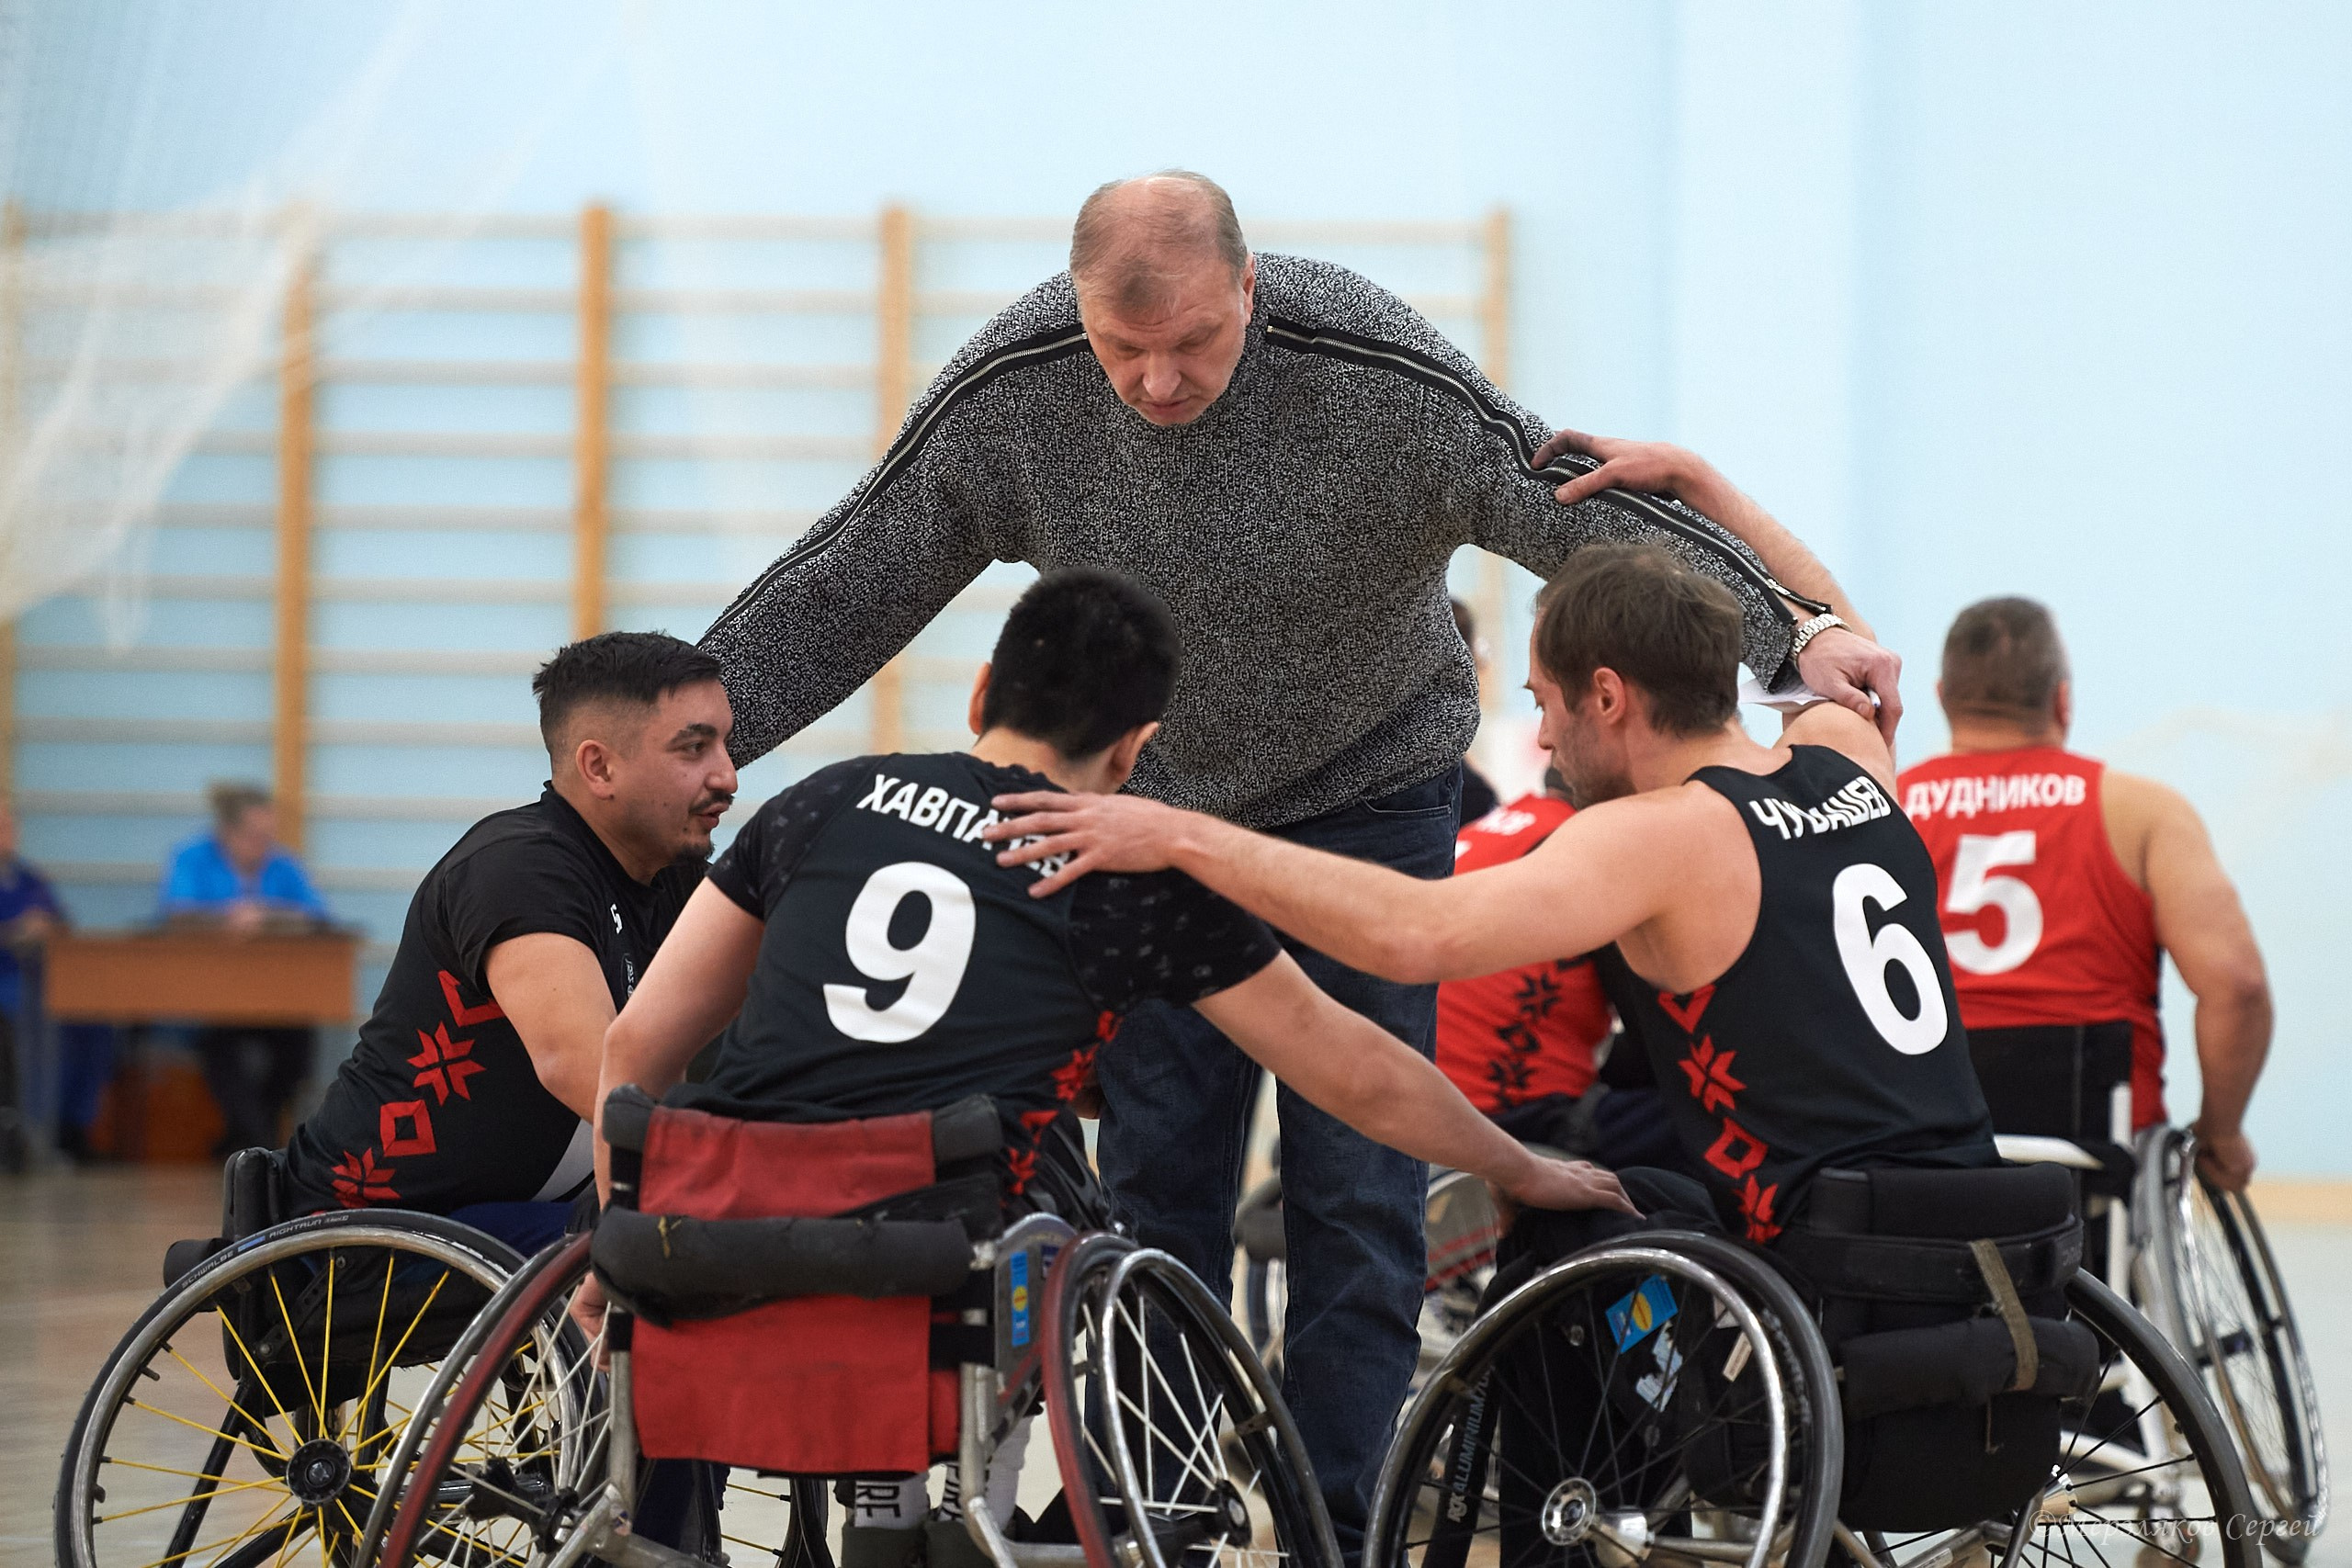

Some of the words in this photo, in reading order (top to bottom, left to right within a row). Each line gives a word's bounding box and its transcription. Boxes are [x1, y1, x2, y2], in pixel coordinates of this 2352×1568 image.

[1905, 773, 2086, 820] ДУДНИКОВ
[822, 861, 978, 1044] 9
[1832, 862, 1949, 1055] 6
[1943, 829, 2044, 976] 5
[181, 1250, 234, 1289] SCHWALBE
